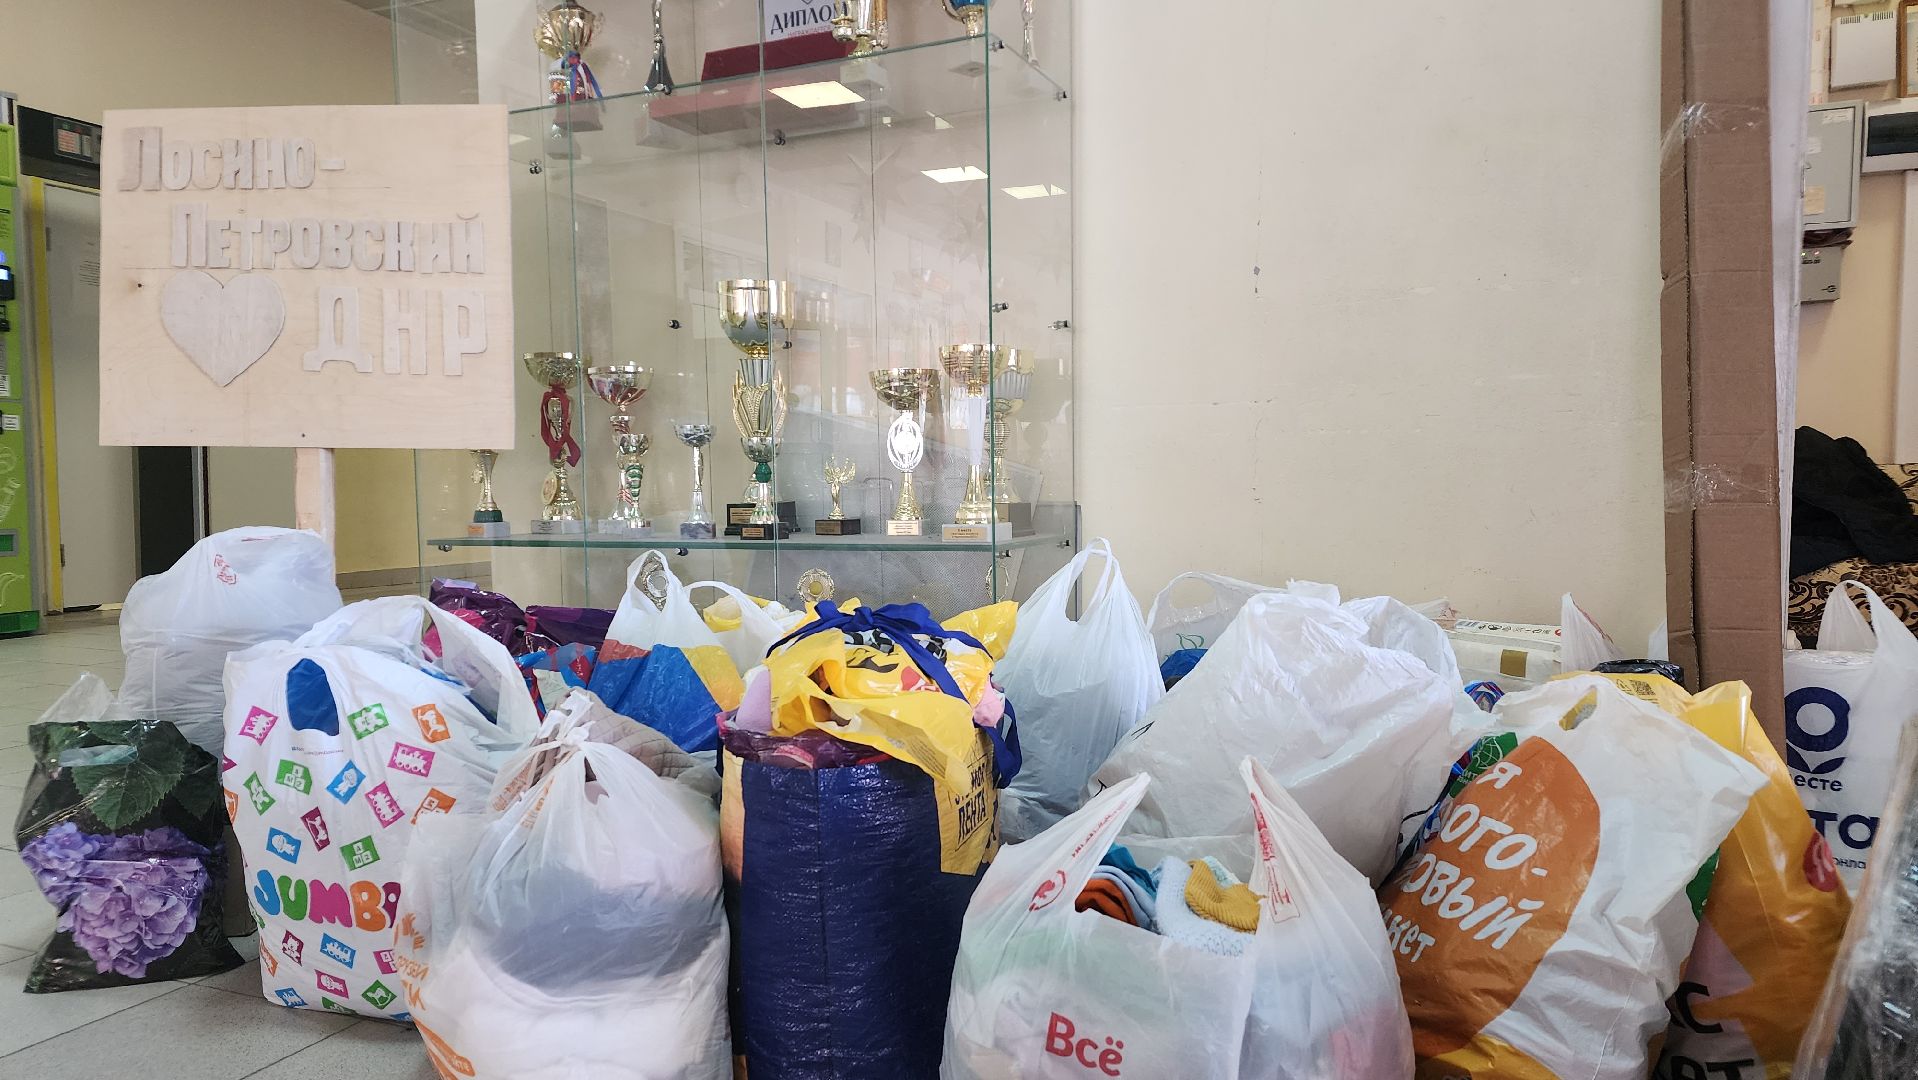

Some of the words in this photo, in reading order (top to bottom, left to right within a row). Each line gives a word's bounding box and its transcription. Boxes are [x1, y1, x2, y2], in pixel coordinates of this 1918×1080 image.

[770, 1, 848, 35] ДИПЛОМ
[303, 286, 488, 377] ДНР
[1476, 761, 1523, 789] Я
[1790, 773, 1843, 792] есте
[1440, 803, 1549, 877] ОГО-
[1806, 808, 1880, 850] та
[1045, 1011, 1124, 1077] Всё
